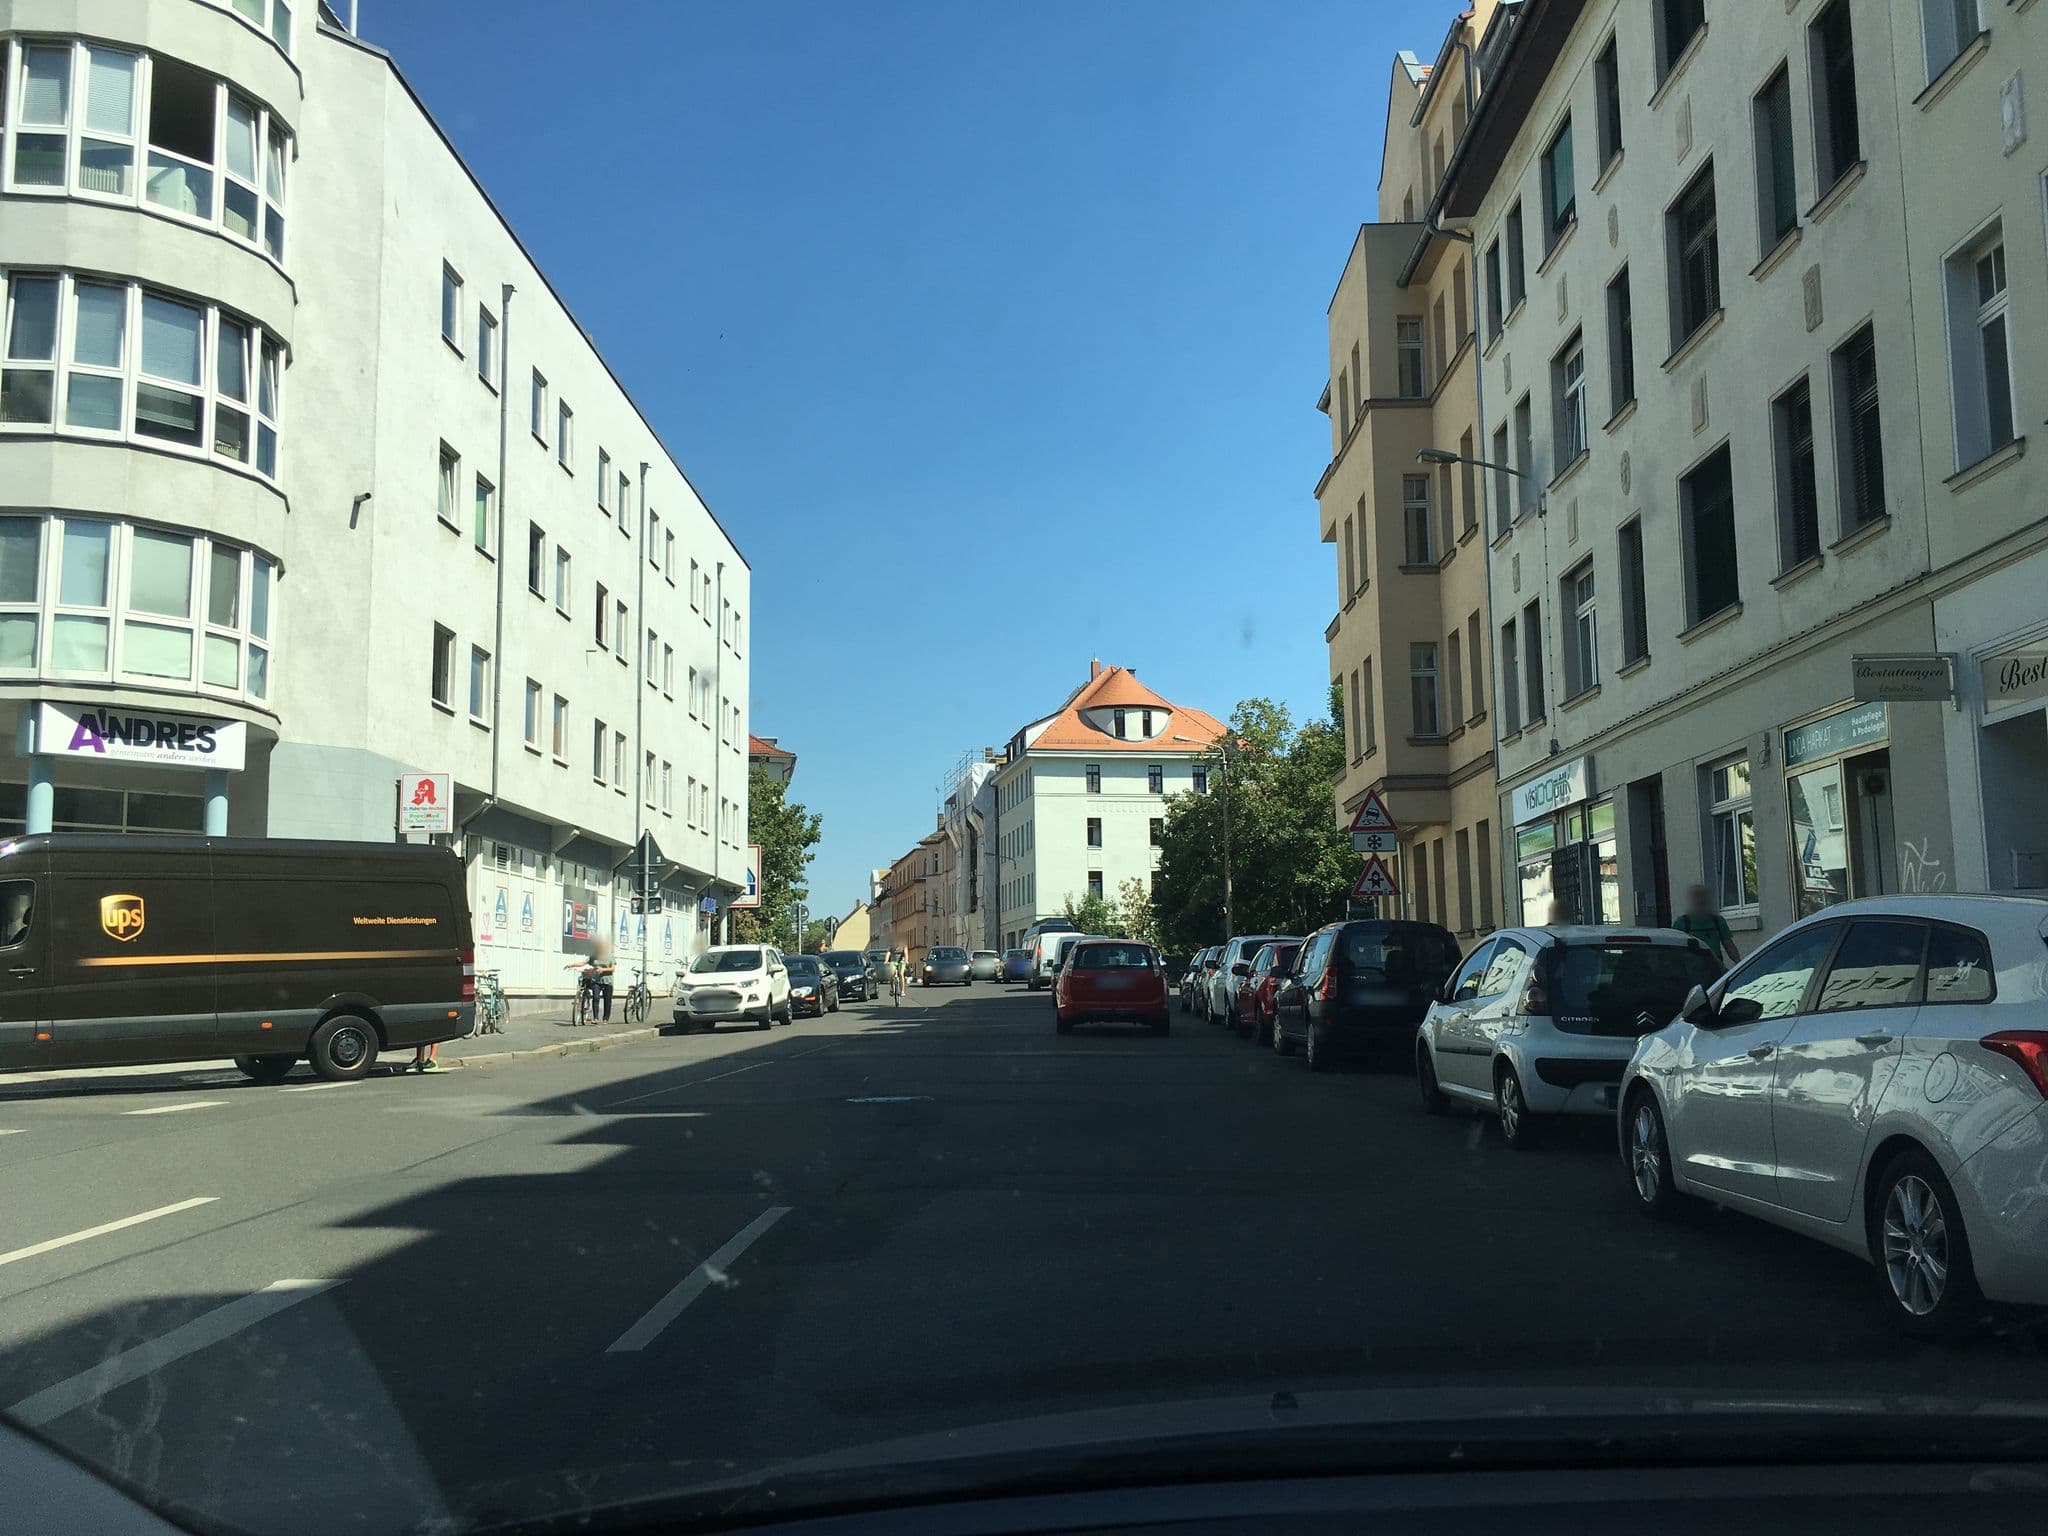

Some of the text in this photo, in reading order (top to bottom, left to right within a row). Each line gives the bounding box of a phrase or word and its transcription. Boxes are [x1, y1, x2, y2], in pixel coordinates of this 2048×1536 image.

[1855, 666, 1945, 680] Bestattungen
[105, 908, 142, 935] ups
[353, 916, 437, 926] Weltweite Dienstleistungen
